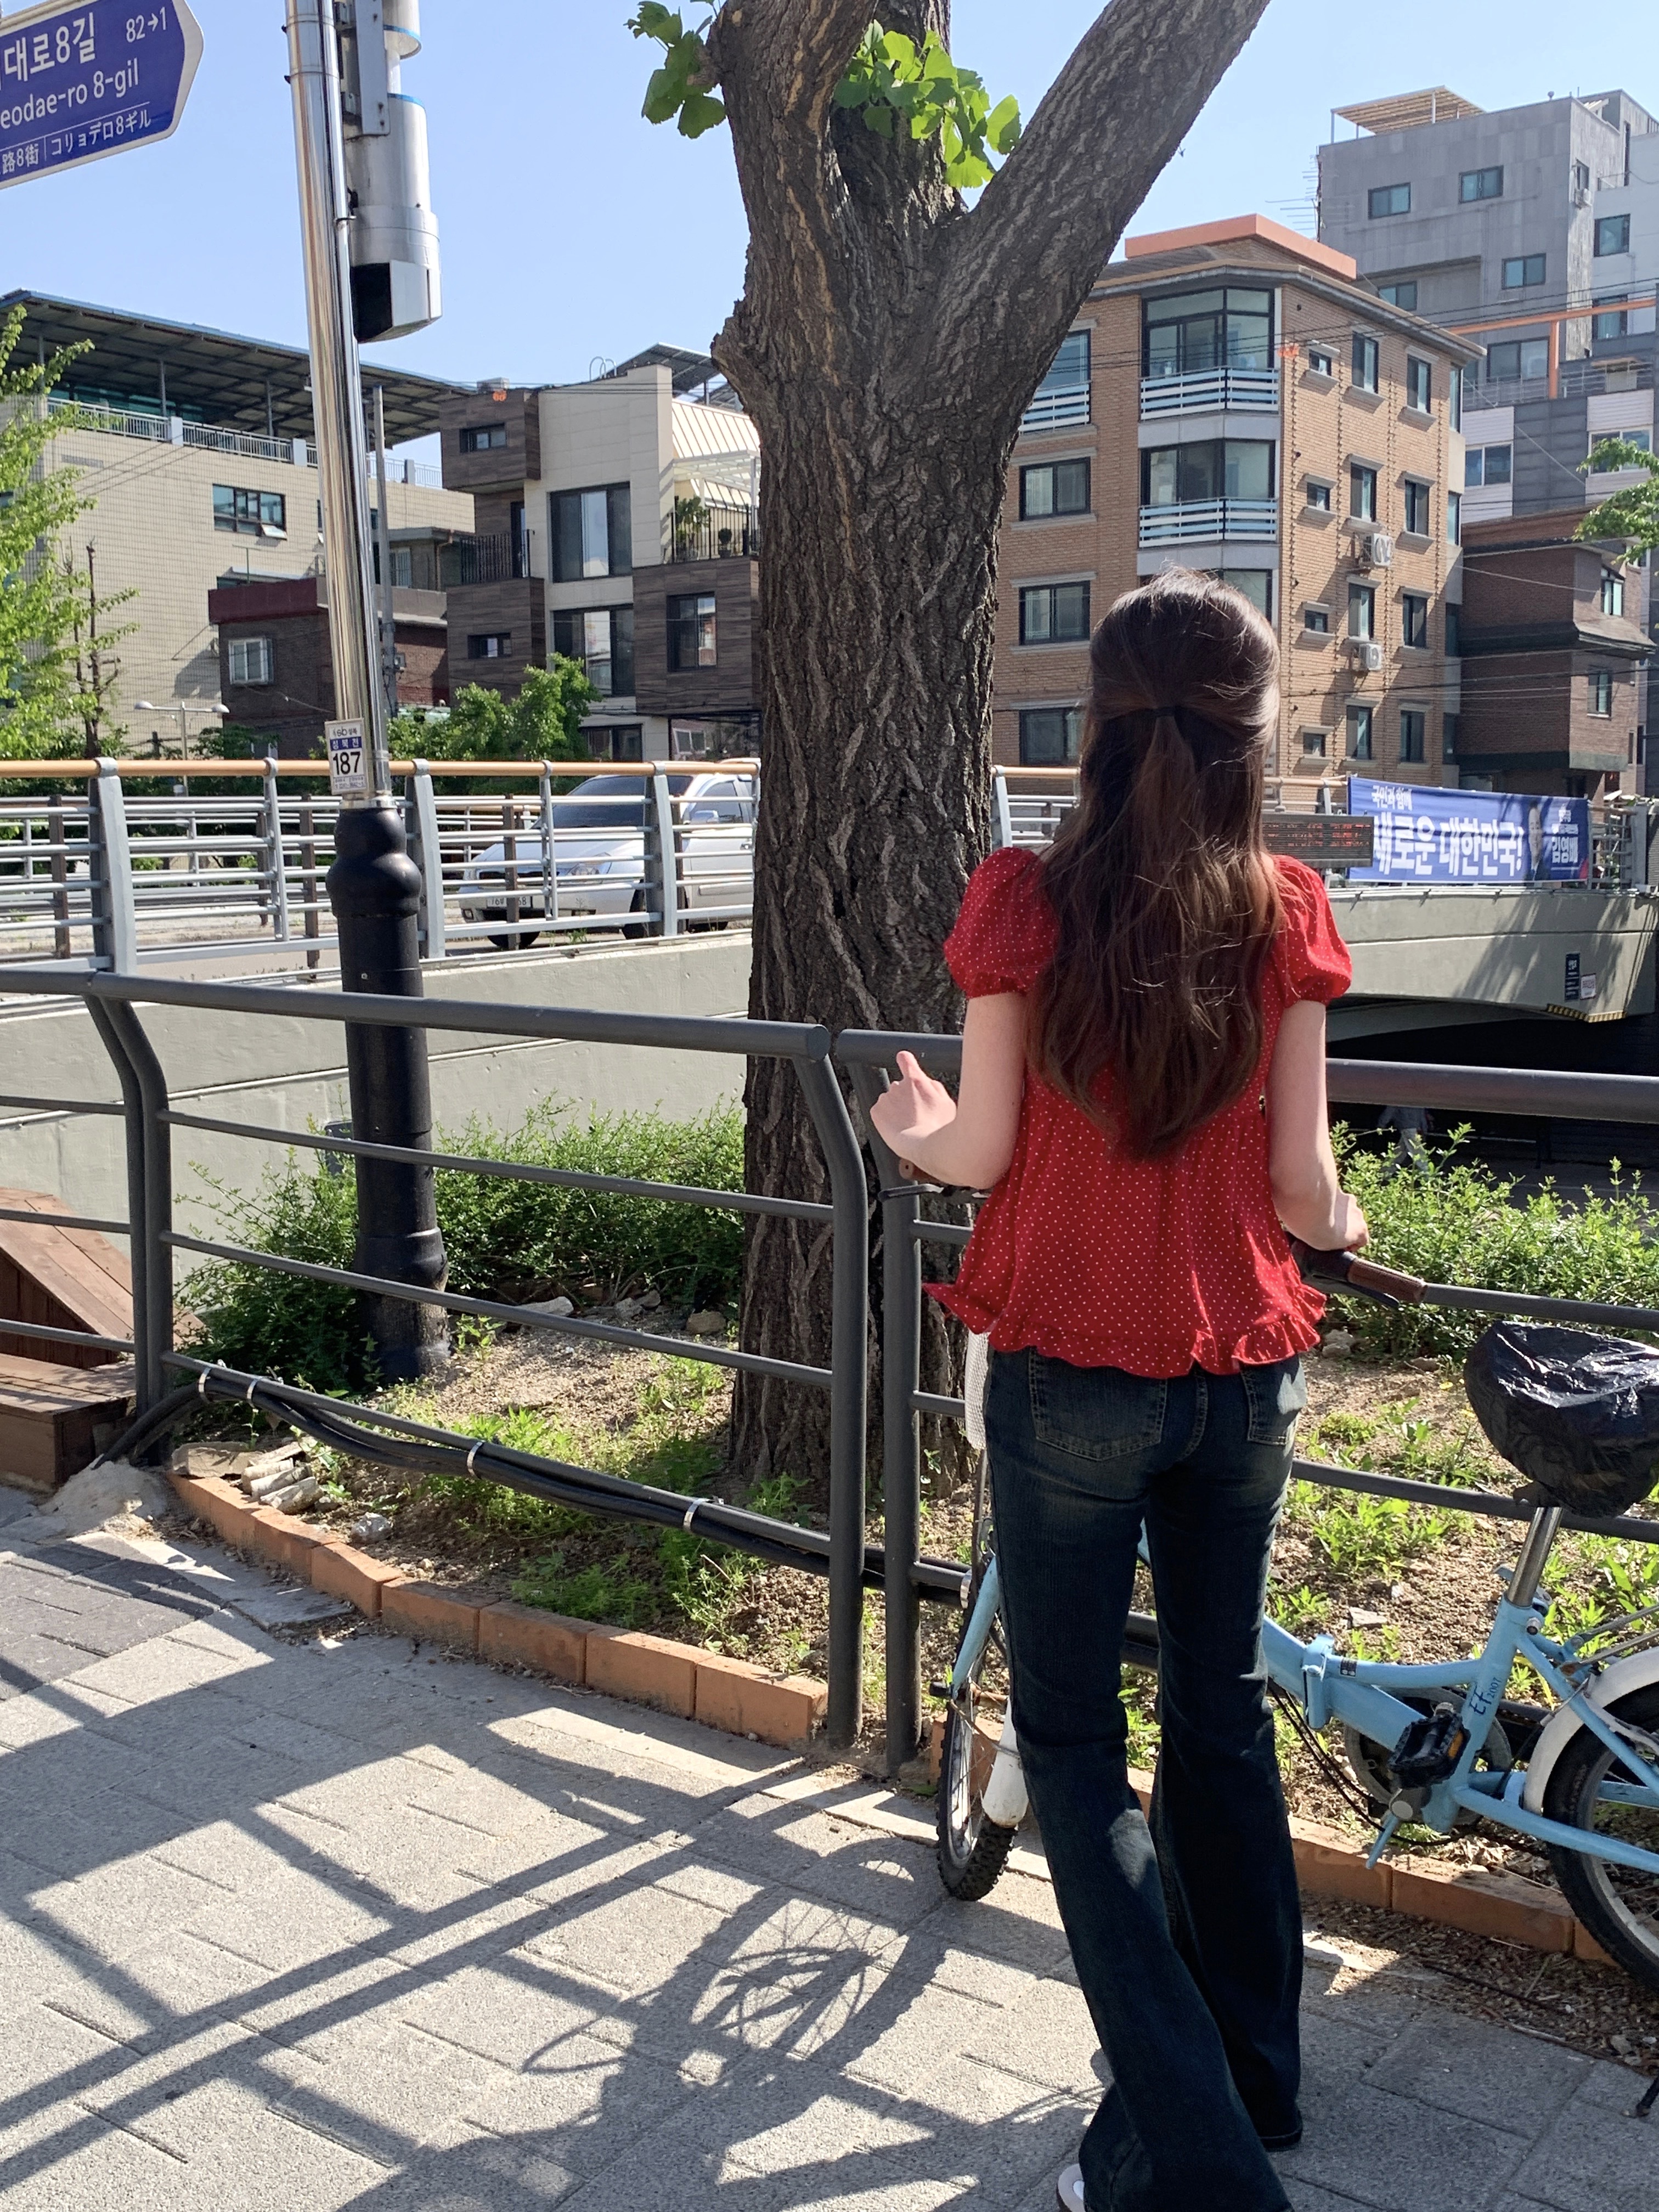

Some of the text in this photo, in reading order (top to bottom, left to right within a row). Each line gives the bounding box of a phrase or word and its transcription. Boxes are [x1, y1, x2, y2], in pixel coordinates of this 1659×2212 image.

[1, 58, 138, 129] eodae-ro 8-gil
[51, 110, 151, 155] コリョデロ8ギル
[333, 752, 361, 775] 187
[1371, 785, 1413, 811] 국민과 함께
[1440, 816, 1525, 877] 대한민국!
[1487, 1677, 1502, 1699] 2007
